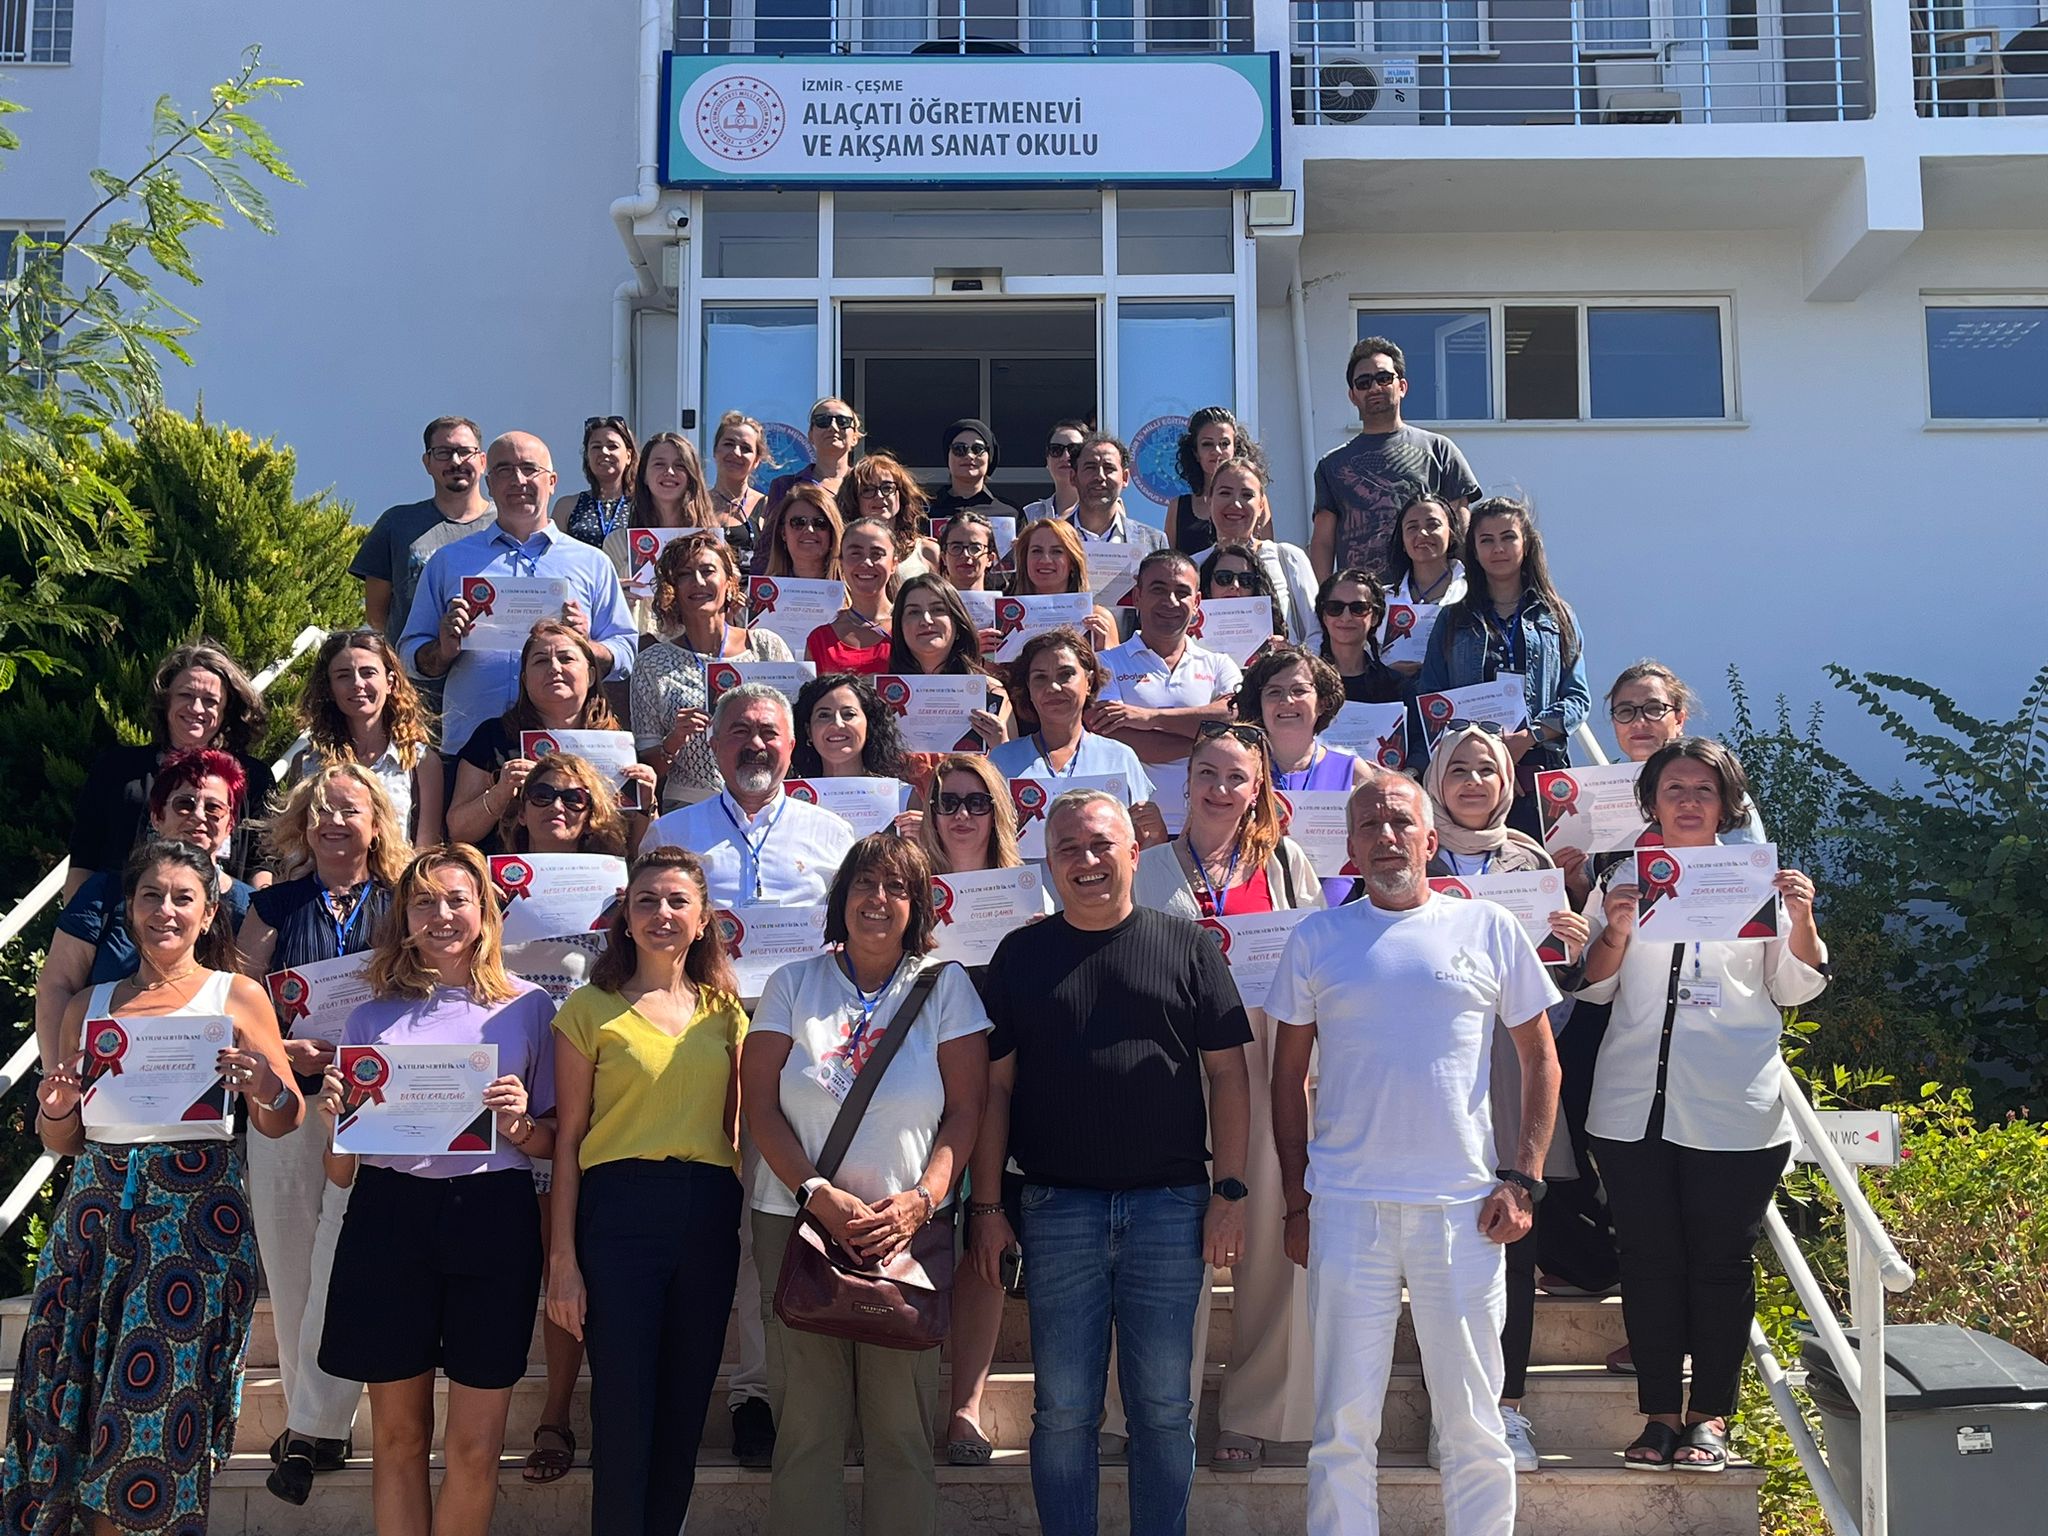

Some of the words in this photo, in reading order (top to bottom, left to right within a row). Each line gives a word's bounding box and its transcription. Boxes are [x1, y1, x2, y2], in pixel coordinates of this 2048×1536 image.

[802, 78, 843, 91] İZMİR
[855, 80, 903, 95] ÇEŞME
[803, 102, 902, 130] ALAÇATI
[909, 97, 1081, 124] ÖĞRETMENEVİ
[802, 134, 832, 157] VE
[838, 134, 924, 162] AKŞAM
[931, 133, 1010, 156] SANAT
[1017, 133, 1098, 156] OKULU
[1841, 1131, 1860, 1145] WC
